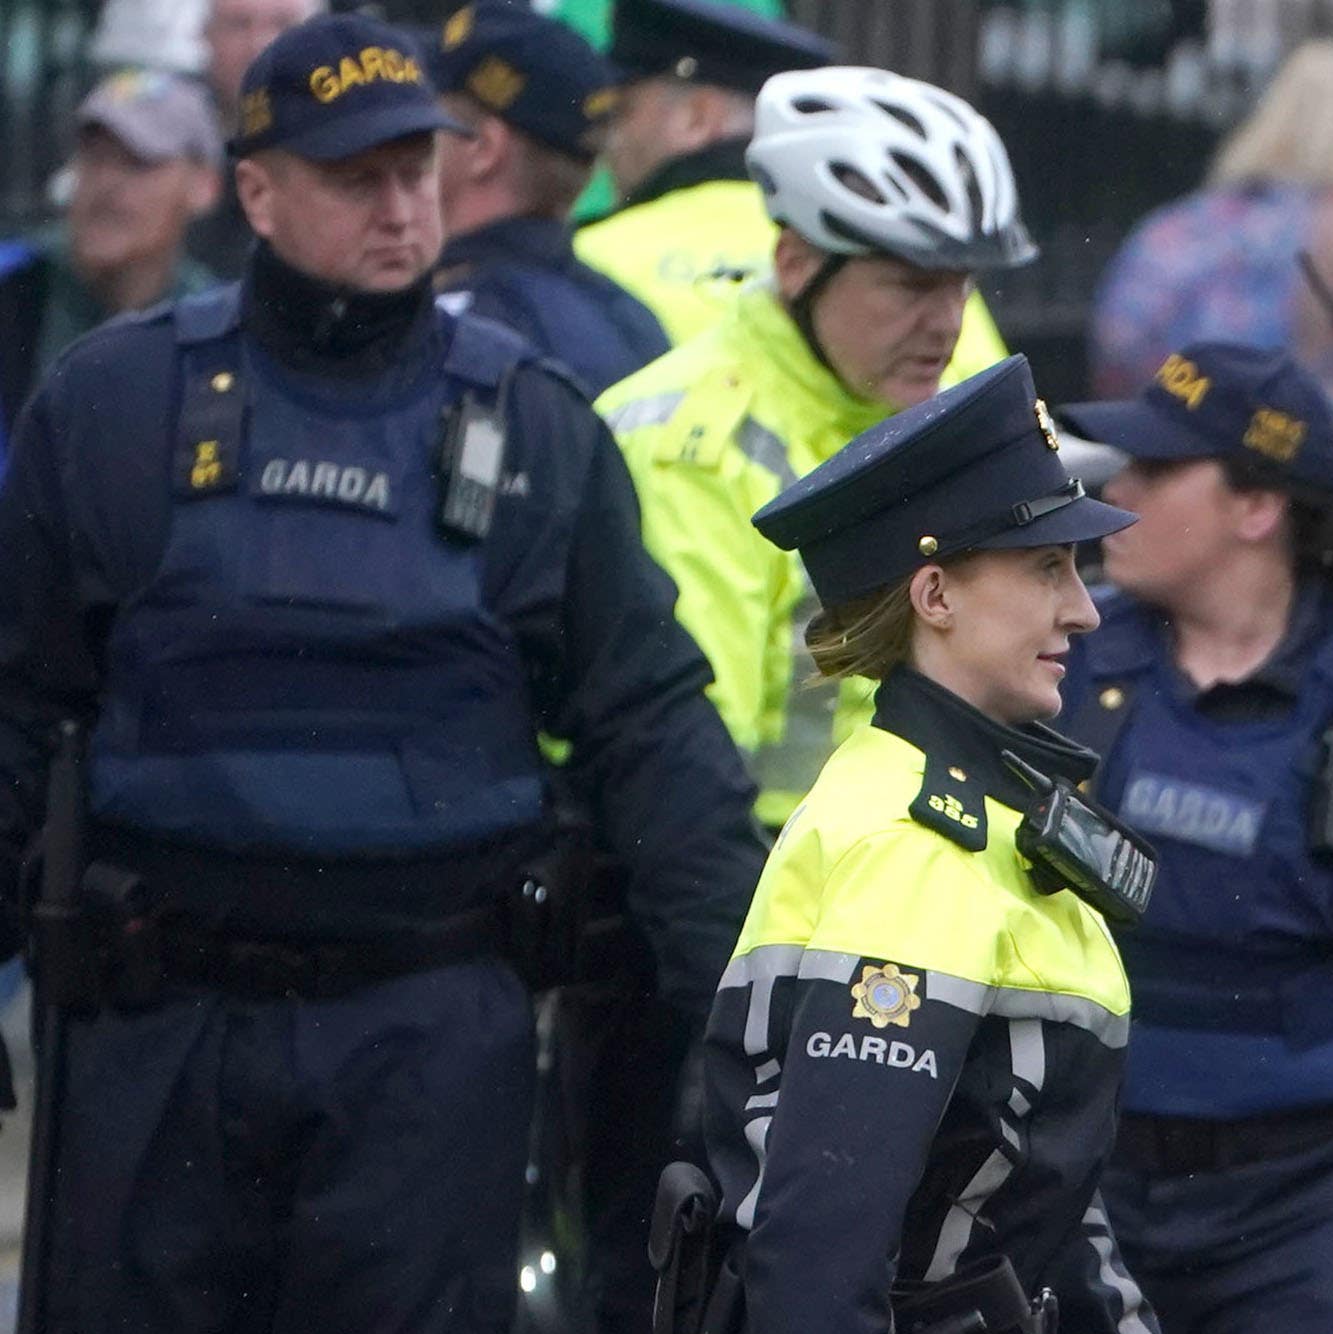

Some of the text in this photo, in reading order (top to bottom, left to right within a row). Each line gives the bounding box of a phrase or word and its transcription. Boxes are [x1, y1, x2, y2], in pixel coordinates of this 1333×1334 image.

[261, 458, 391, 511] GARDA
[1127, 778, 1258, 845] GARDA
[806, 1031, 938, 1079] GARDA
